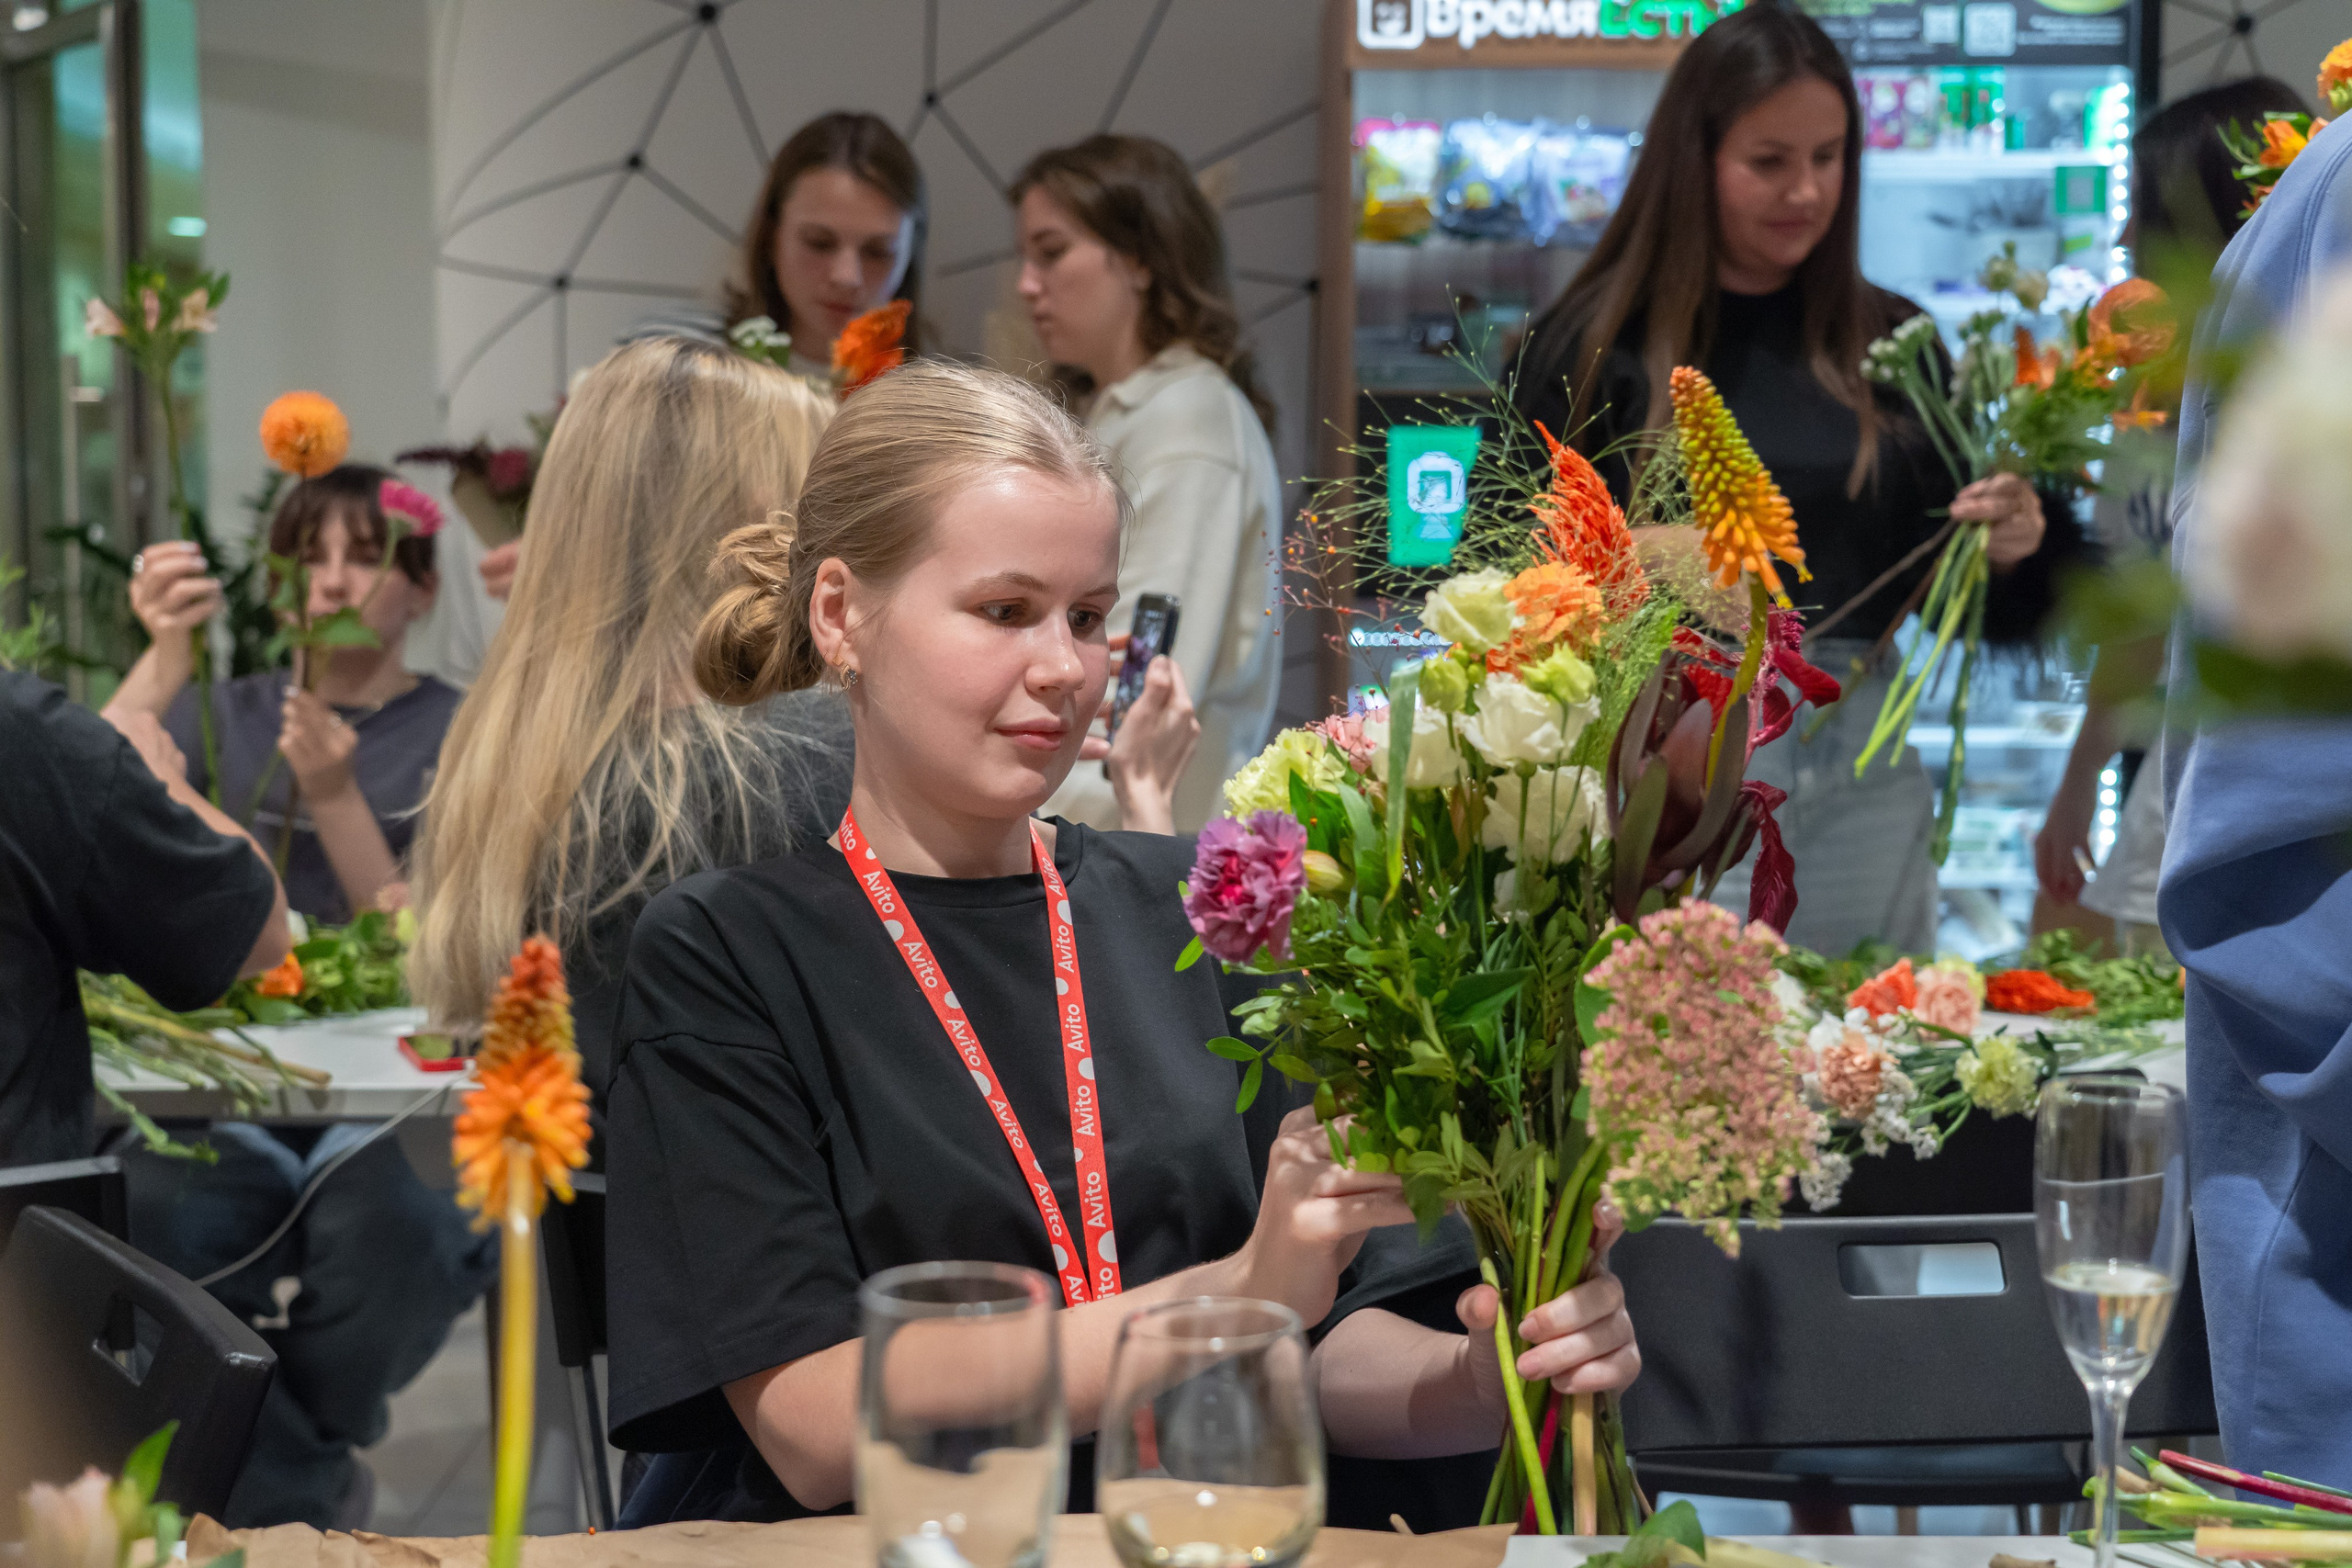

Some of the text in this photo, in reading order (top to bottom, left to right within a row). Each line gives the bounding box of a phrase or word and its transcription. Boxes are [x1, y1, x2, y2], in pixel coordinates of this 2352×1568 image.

[863, 870, 896, 914] Avito
[1041, 856, 1063, 897] Avito
[902, 942, 938, 989] Avito
[1056, 924, 1075, 974] Avito
[946, 1018, 982, 1067] Avito
[1066, 1003, 1086, 1054] Avito
[990, 1099, 1024, 1150] Avito
[1075, 1084, 1097, 1138] Avito
[1034, 1182, 1063, 1237] Avito
[1085, 1171, 1107, 1229] Avito
[1066, 1275, 1090, 1305] Av
[1097, 1267, 1115, 1300] ito
